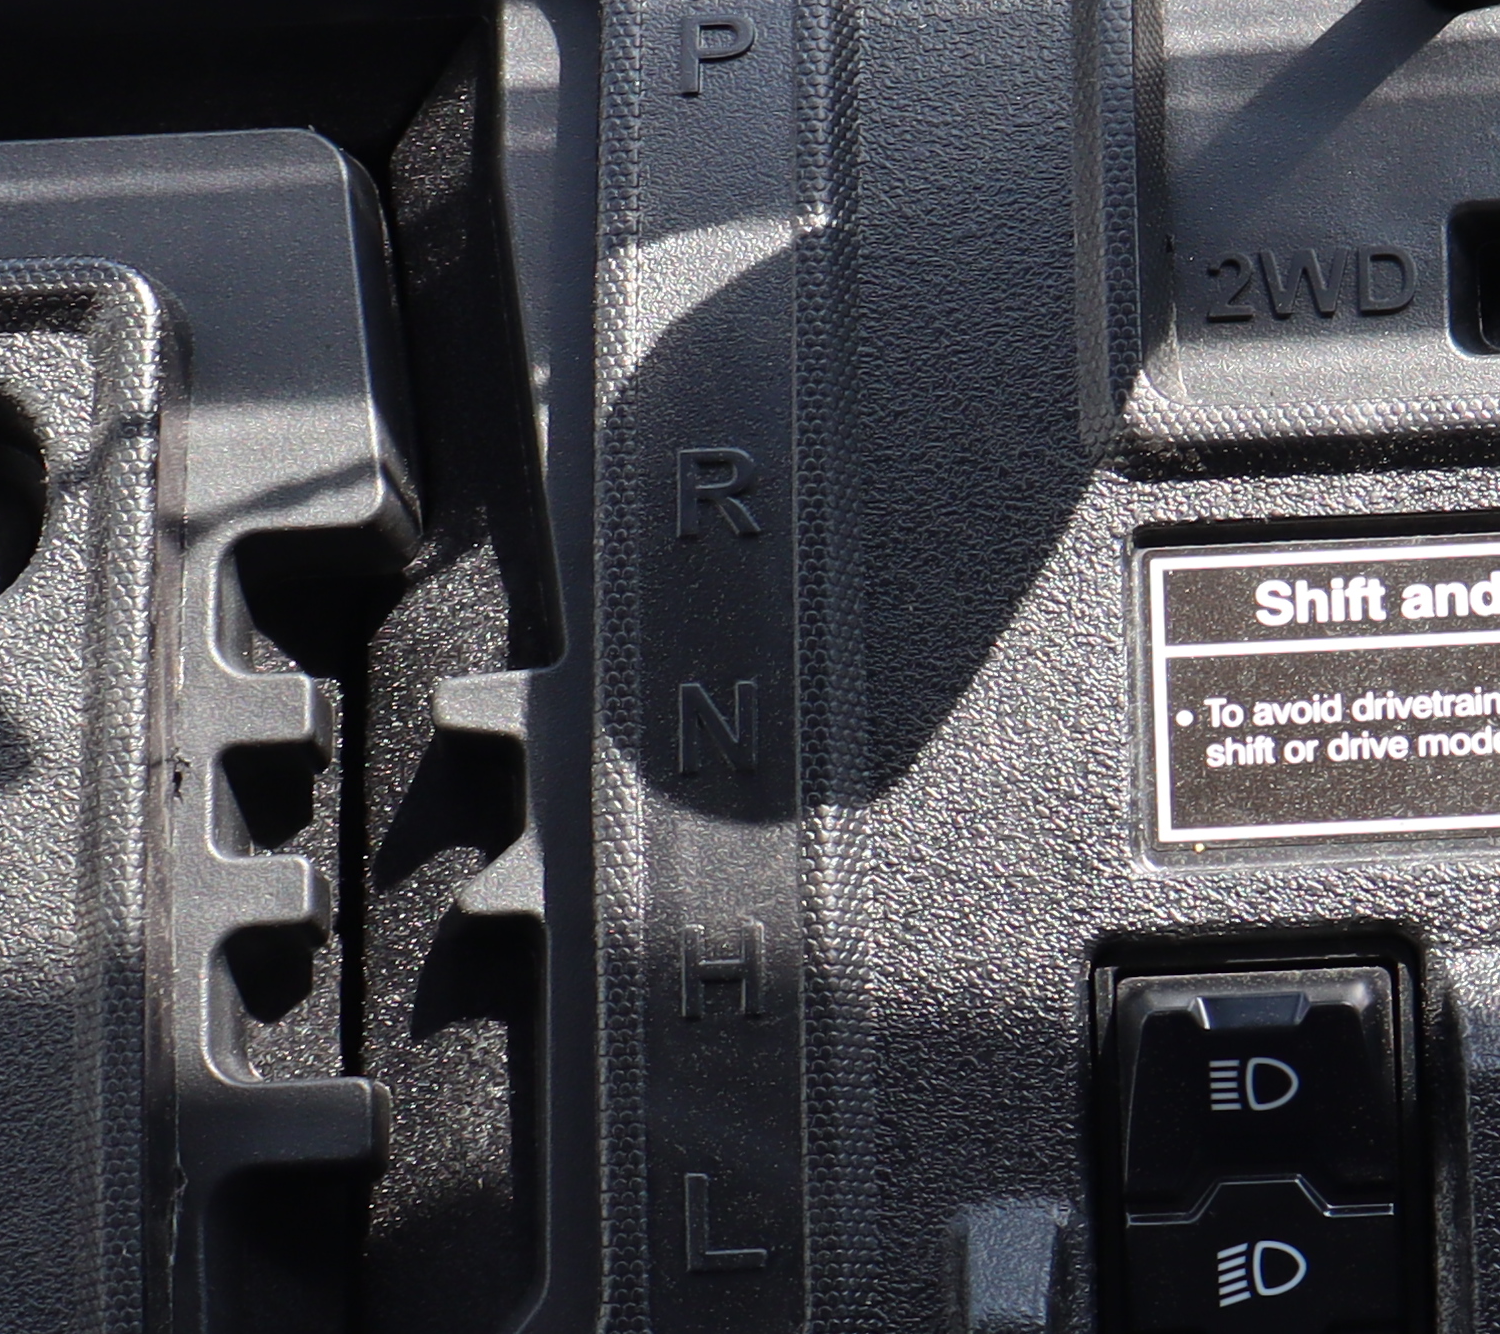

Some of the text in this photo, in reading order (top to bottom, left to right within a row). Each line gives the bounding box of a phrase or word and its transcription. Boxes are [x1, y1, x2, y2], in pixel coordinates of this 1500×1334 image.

[680, 16, 756, 97] P
[1206, 245, 1418, 322] 2WD
[676, 447, 761, 538] R
[1255, 576, 1387, 626] Shift
[678, 679, 758, 774] N
[1204, 698, 1244, 728] To
[1253, 693, 1342, 726] avoid
[1206, 735, 1275, 767] shift
[1284, 740, 1319, 764] or
[1327, 731, 1409, 762] drive
[680, 919, 764, 1017] H
[685, 1172, 768, 1273] L
